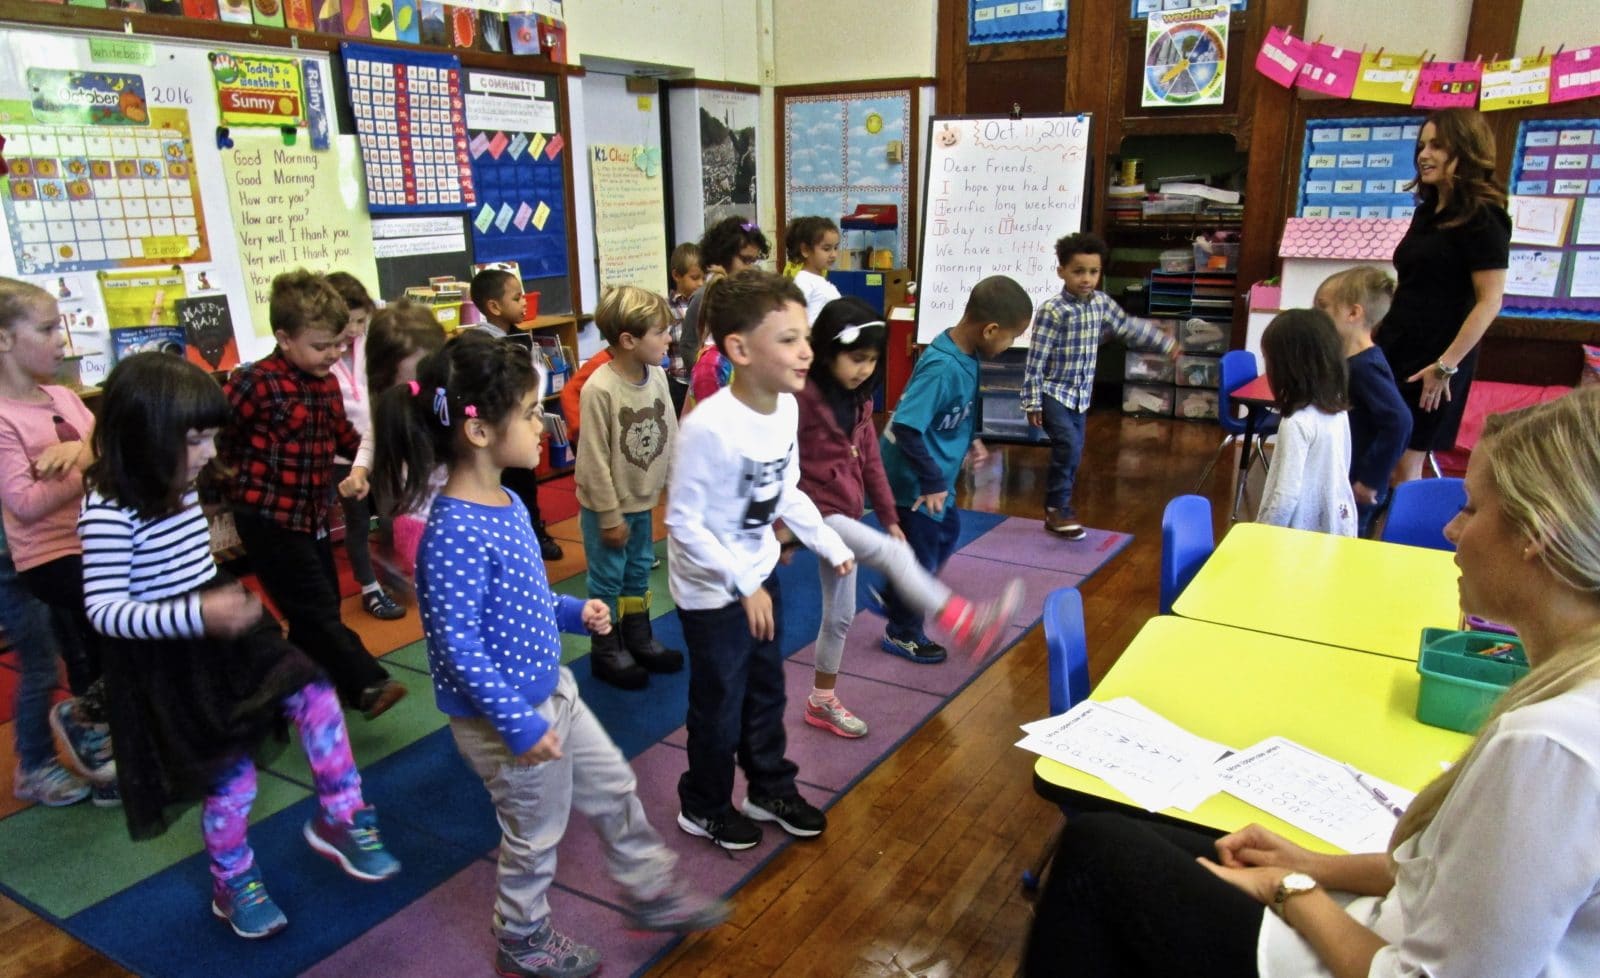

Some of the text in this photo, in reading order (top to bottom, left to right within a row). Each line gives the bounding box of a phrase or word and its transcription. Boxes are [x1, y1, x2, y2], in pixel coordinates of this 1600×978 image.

[1163, 8, 1218, 23] weather
[244, 62, 280, 78] Today's
[239, 77, 291, 88] weather is
[307, 68, 322, 112] Rainy
[60, 87, 119, 105] October
[152, 86, 193, 105] 2016
[231, 93, 275, 113] Sunny
[234, 149, 261, 166] Good
[595, 146, 607, 161] K2
[1315, 156, 1329, 166] play
[1370, 157, 1390, 166] pretty
[944, 157, 976, 172] Dear
[1526, 158, 1582, 167] what where
[236, 169, 315, 188] Good Morning
[942, 176, 1068, 197] I hope you had a
[1559, 181, 1582, 190] yellow
[239, 189, 310, 209] How are you?
[994, 198, 1016, 215] long
[242, 208, 309, 229] How are you?
[240, 231, 262, 250] Very
[291, 228, 296, 243] I
[301, 225, 327, 240] thank
[936, 222, 975, 241] Today
[984, 225, 993, 234] is
[244, 252, 264, 270] Very
[293, 247, 298, 261] I
[303, 244, 328, 259] thank
[936, 243, 953, 256] We
[964, 242, 990, 255] have
[1012, 241, 1046, 254] little
[251, 271, 271, 285] How
[936, 264, 981, 280] morning
[992, 260, 1022, 272] work
[933, 281, 949, 293] We
[183, 302, 225, 322] NAPPY
[931, 299, 954, 310] and
[86, 360, 106, 375] Day
